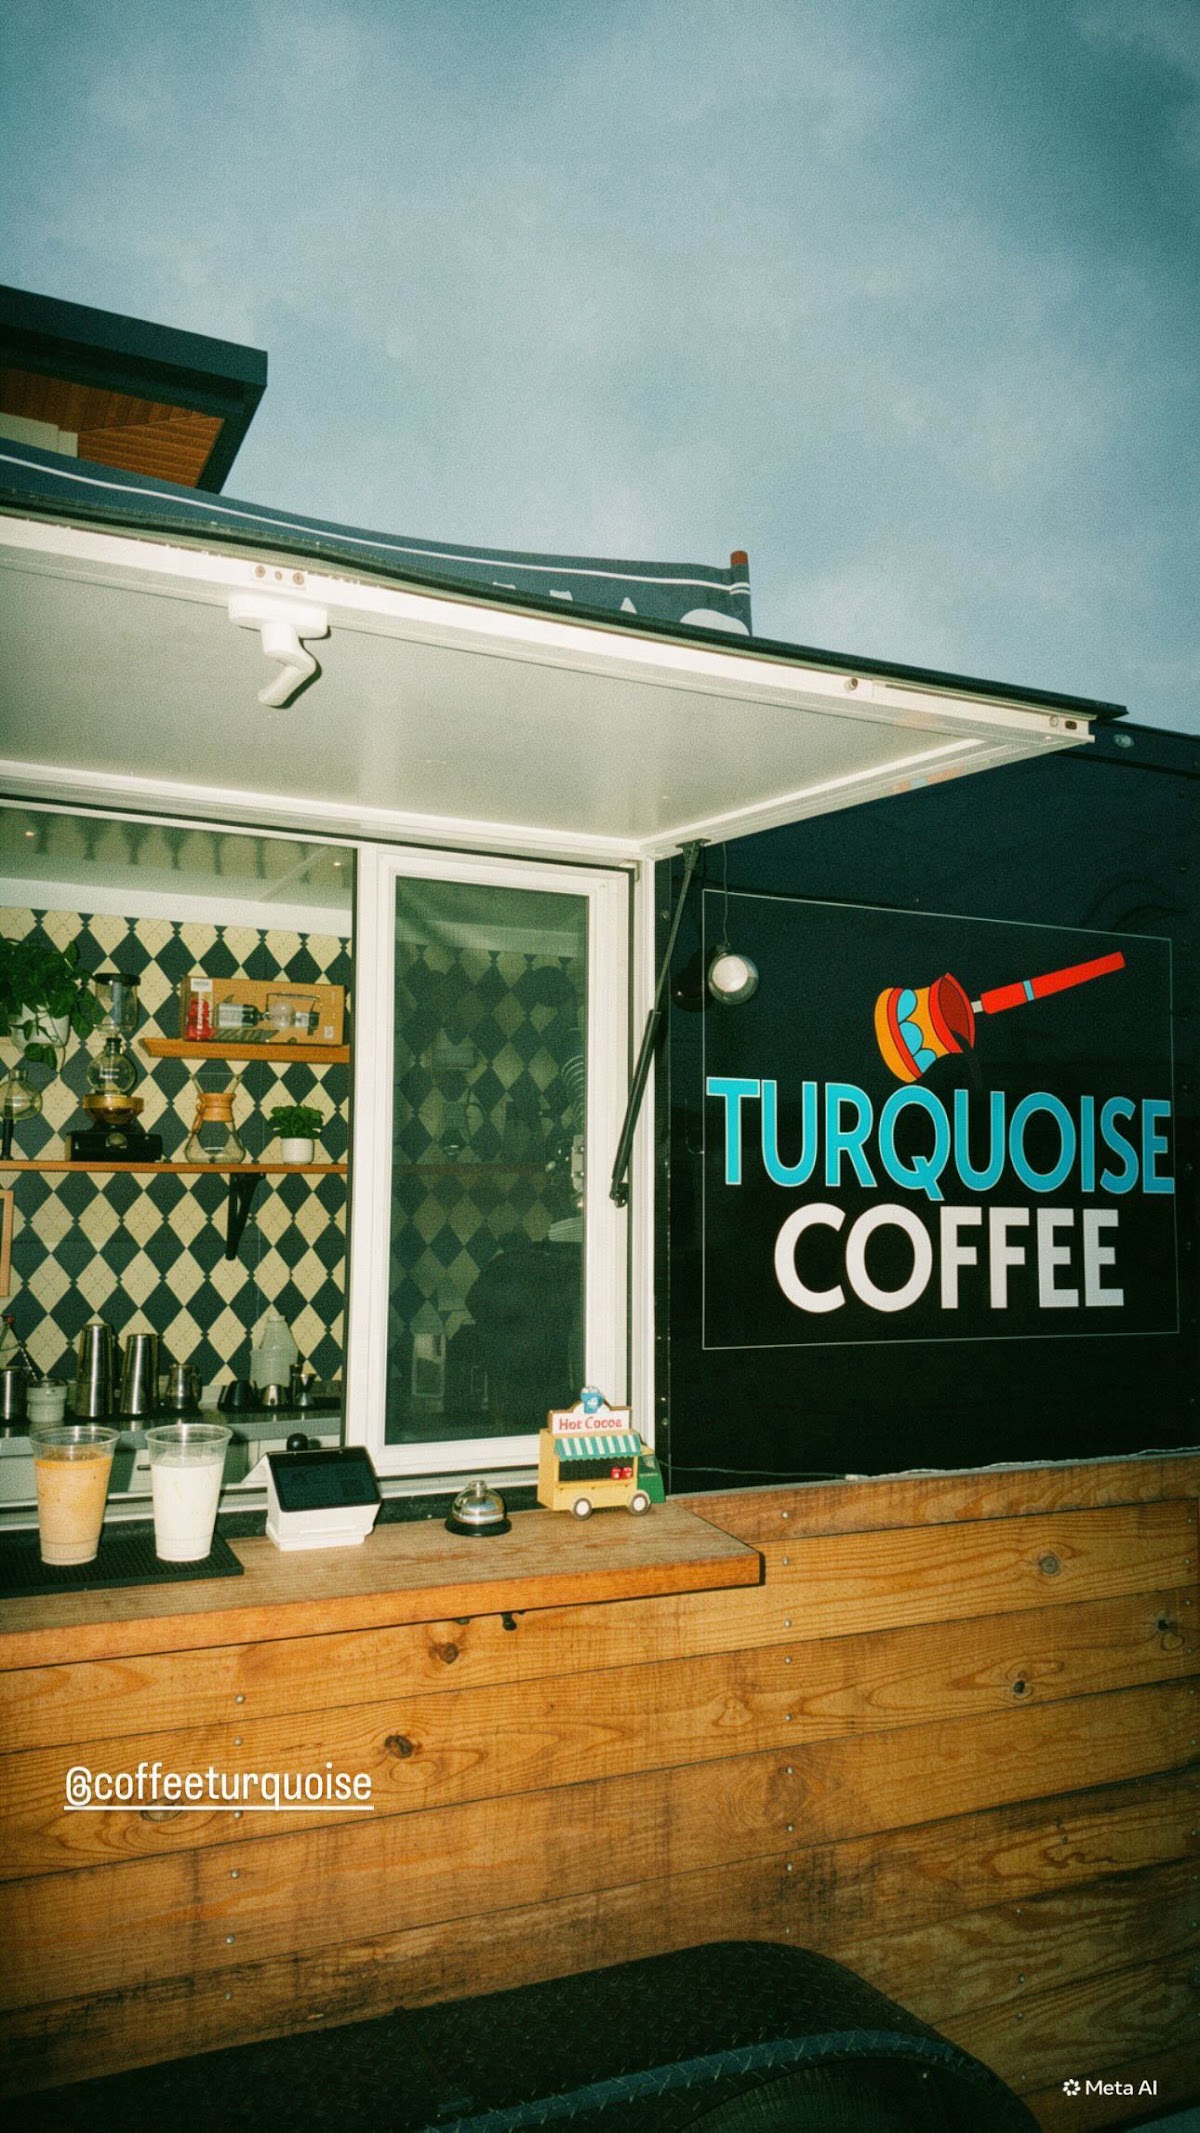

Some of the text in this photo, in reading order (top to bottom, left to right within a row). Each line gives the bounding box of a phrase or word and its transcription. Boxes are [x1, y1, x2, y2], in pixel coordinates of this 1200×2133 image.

[706, 1077, 1175, 1201] TURQUOISE
[774, 1203, 1124, 1313] COFFEE
[559, 1416, 622, 1430] Hot Cocoa
